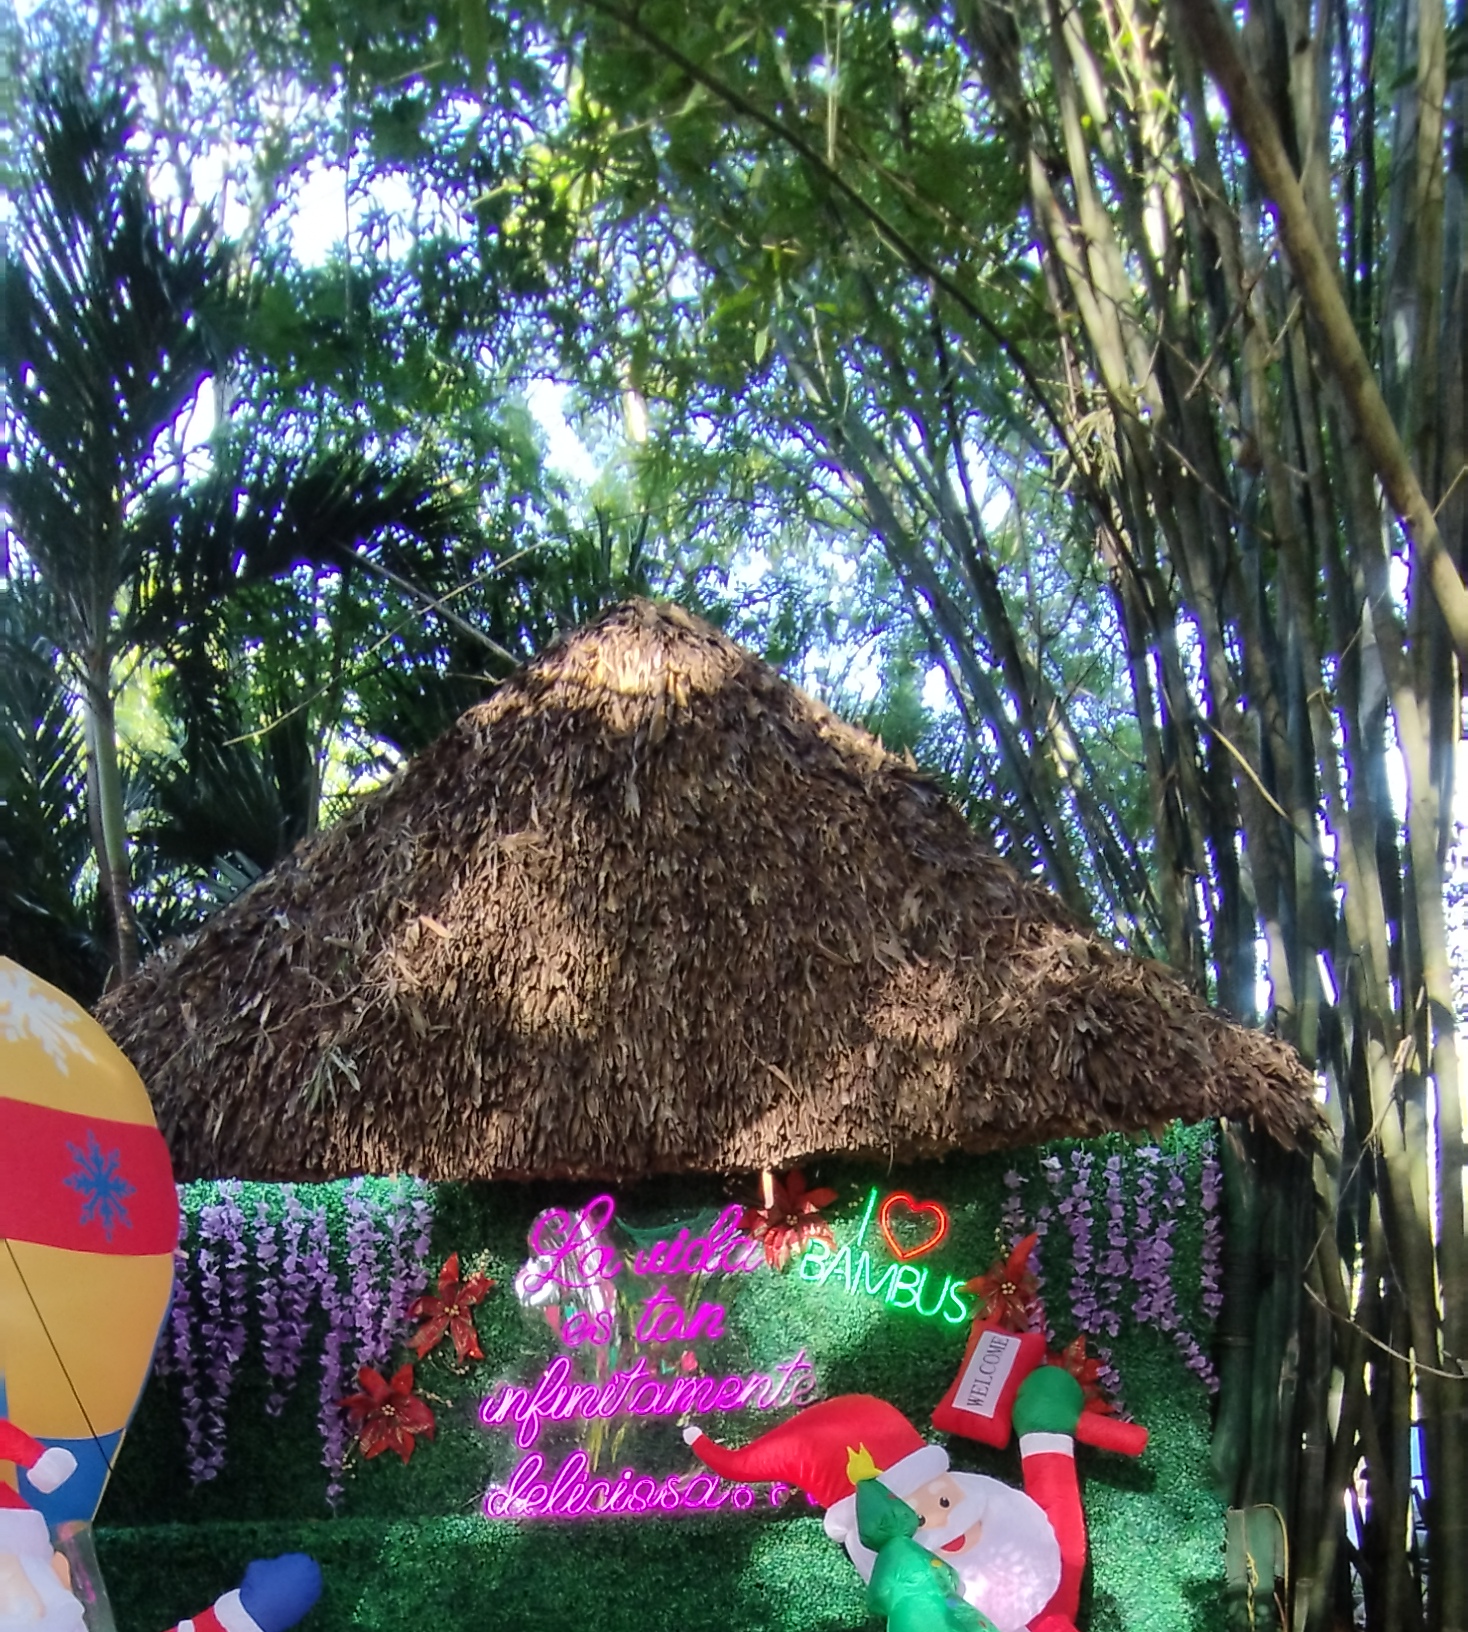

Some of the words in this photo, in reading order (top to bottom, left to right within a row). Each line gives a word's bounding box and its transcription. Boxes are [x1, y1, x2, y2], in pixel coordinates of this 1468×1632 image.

[515, 1193, 623, 1293] La
[634, 1203, 765, 1276] vida
[857, 1186, 878, 1247] I
[561, 1311, 614, 1346] es
[636, 1285, 726, 1343] tan
[799, 1237, 968, 1324] BAMBUS
[480, 1350, 818, 1448] infinitamente
[966, 1335, 1010, 1408] WELCOME
